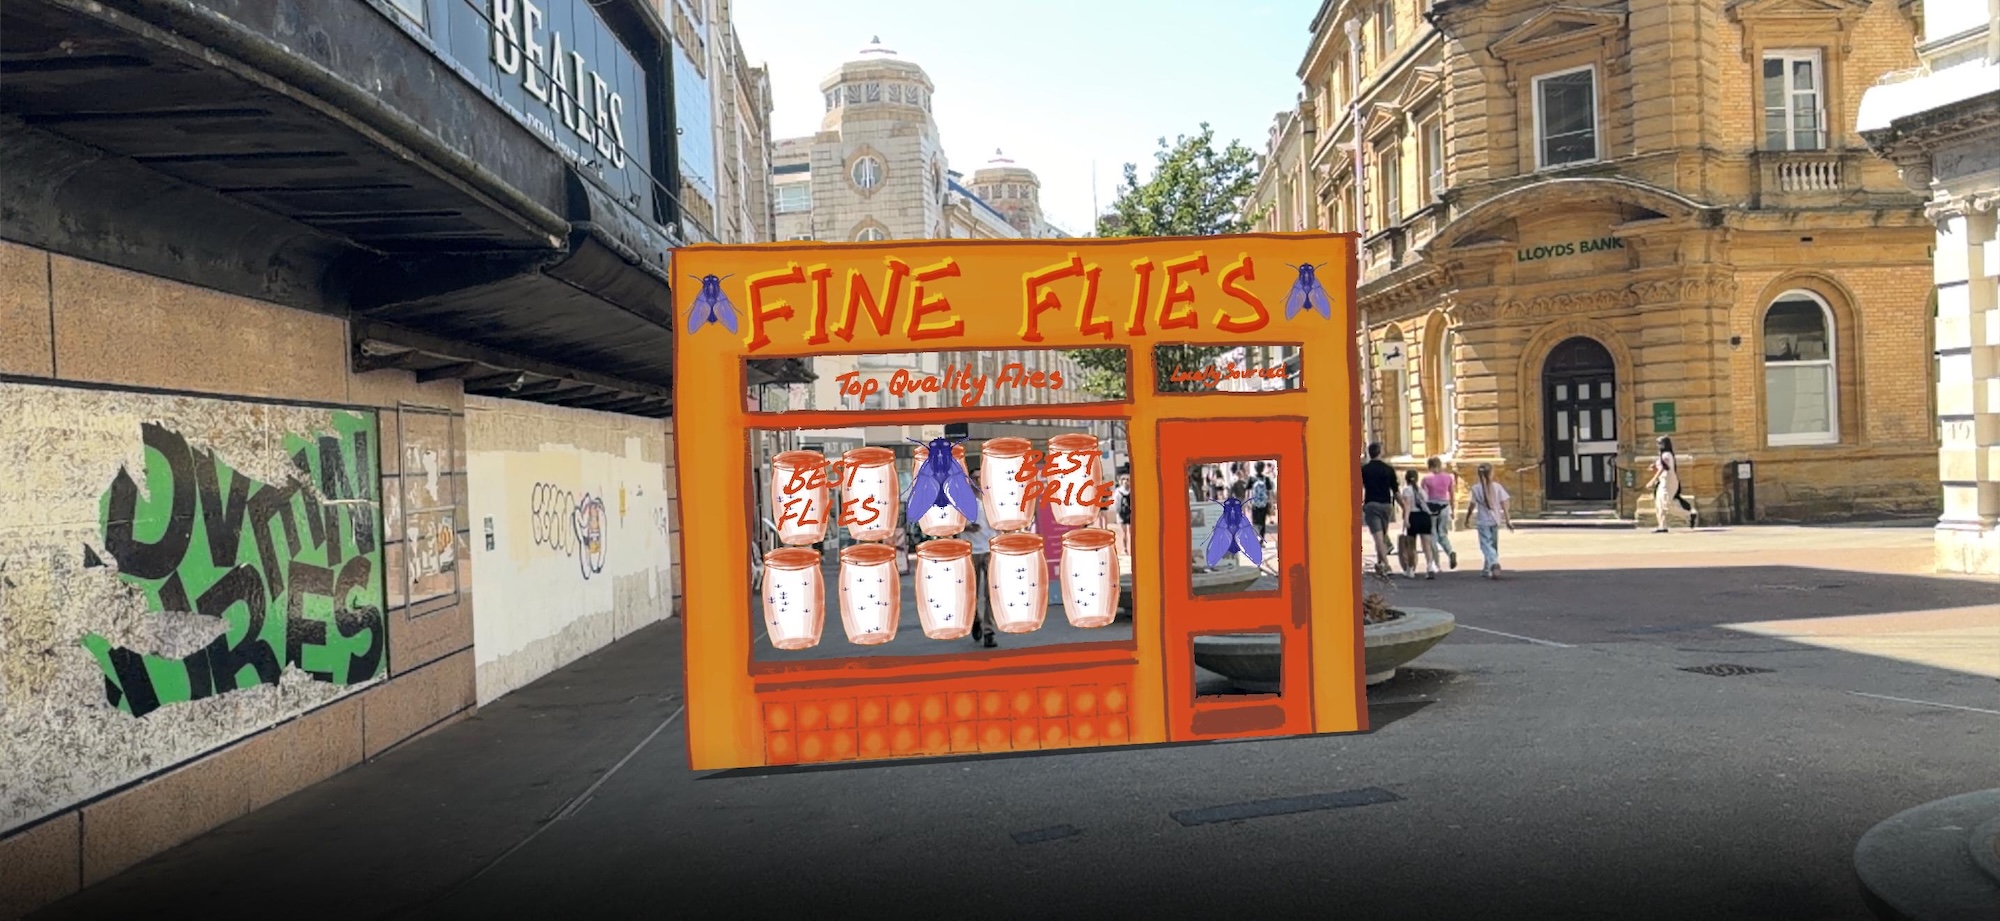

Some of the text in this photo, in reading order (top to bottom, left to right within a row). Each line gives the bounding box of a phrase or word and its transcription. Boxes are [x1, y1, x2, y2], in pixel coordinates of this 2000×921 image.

[493, 0, 625, 169] BEALES
[1518, 237, 1625, 262] LLOYDS BANK
[743, 250, 1269, 352] FINE FLIES
[835, 363, 1063, 407] Top Quality Flies
[1169, 362, 1290, 388] Locally Sourced
[783, 457, 874, 495] BEST
[1014, 449, 1103, 482] BEST
[1020, 479, 1115, 512] PRICE
[777, 497, 880, 532] FLIES
